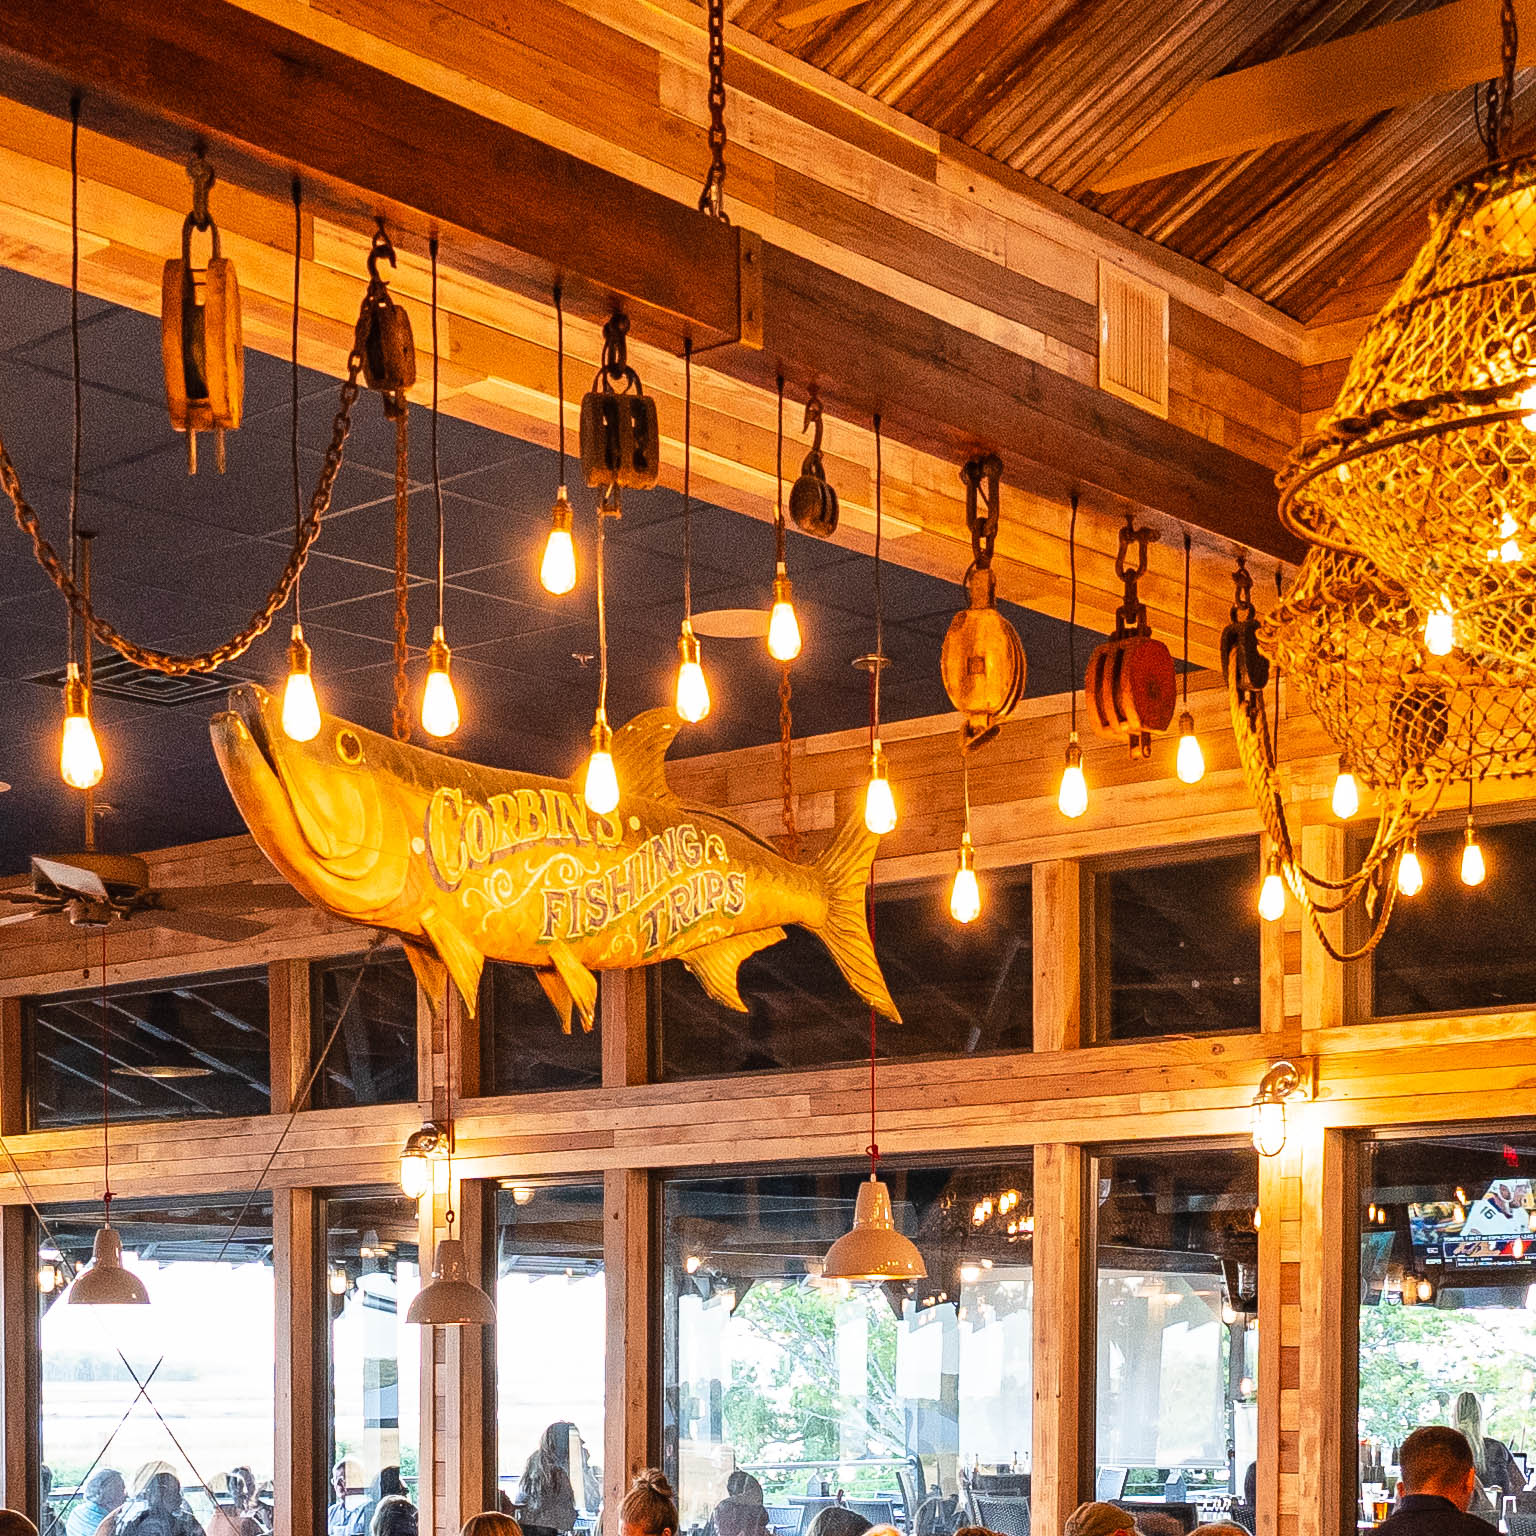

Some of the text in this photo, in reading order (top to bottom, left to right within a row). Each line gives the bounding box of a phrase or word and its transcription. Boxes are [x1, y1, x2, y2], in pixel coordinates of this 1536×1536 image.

[539, 823, 703, 942] FISHING
[639, 869, 747, 953] TRIPS
[1480, 1206, 1497, 1220] 16
